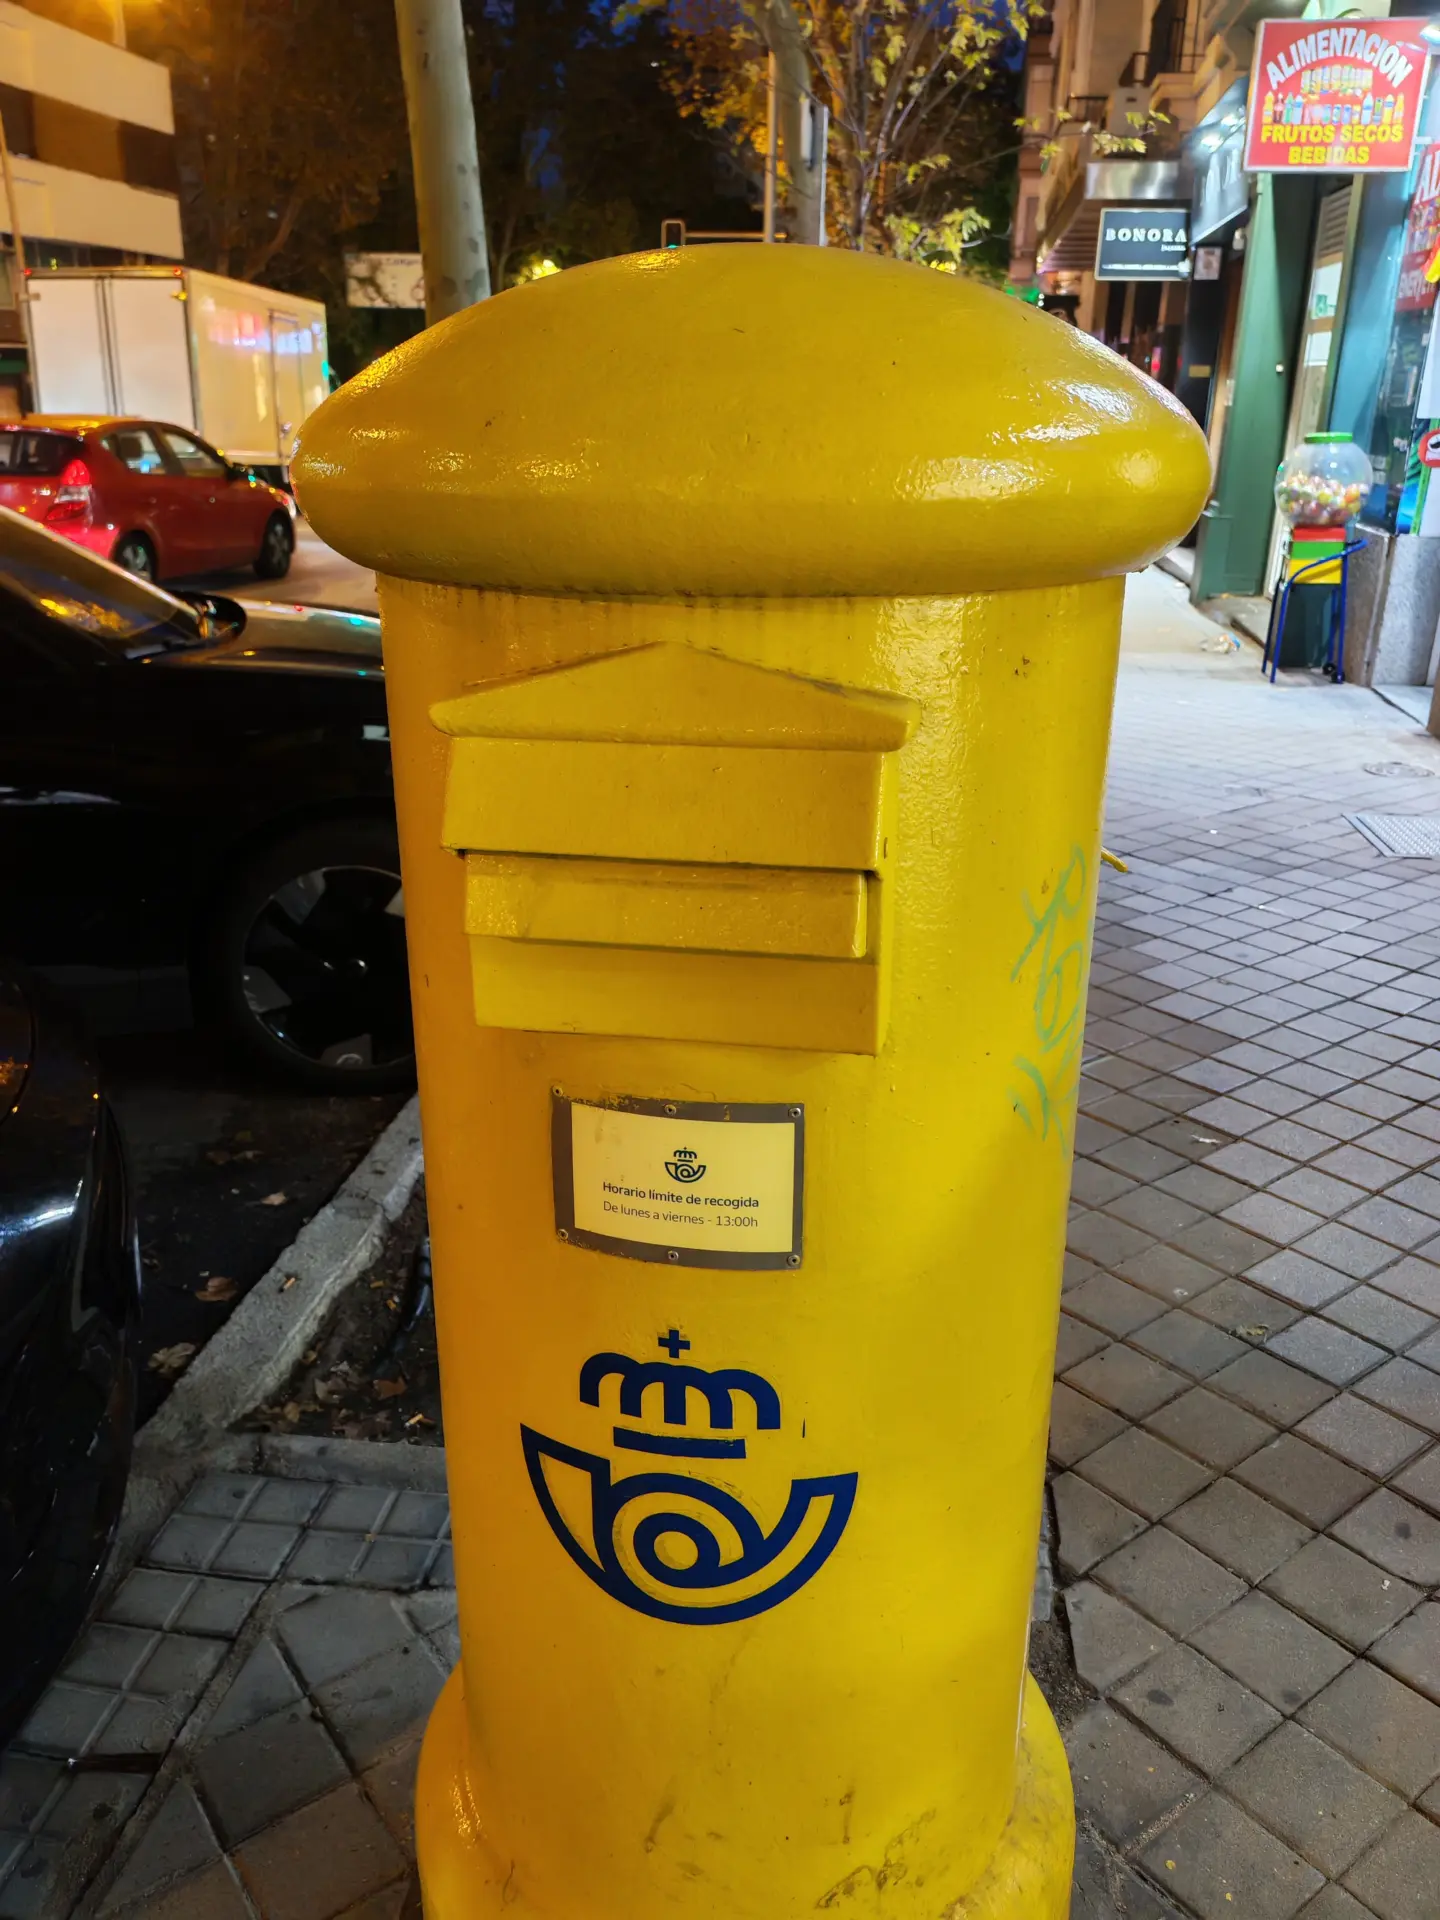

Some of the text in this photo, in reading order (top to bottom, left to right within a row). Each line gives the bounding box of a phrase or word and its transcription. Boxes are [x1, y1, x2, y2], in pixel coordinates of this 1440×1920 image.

[1260, 124, 1404, 144] FRUTOS SECOS
[1288, 145, 1370, 164] BEBIDAS
[1105, 227, 1187, 243] BONORA
[603, 1181, 759, 1209] Horario límite de recogida
[603, 1200, 619, 1213] De
[620, 1203, 650, 1219] lunes
[652, 1211, 660, 1220] a
[662, 1211, 705, 1225] viernes
[715, 1215, 758, 1227] 13:00h
